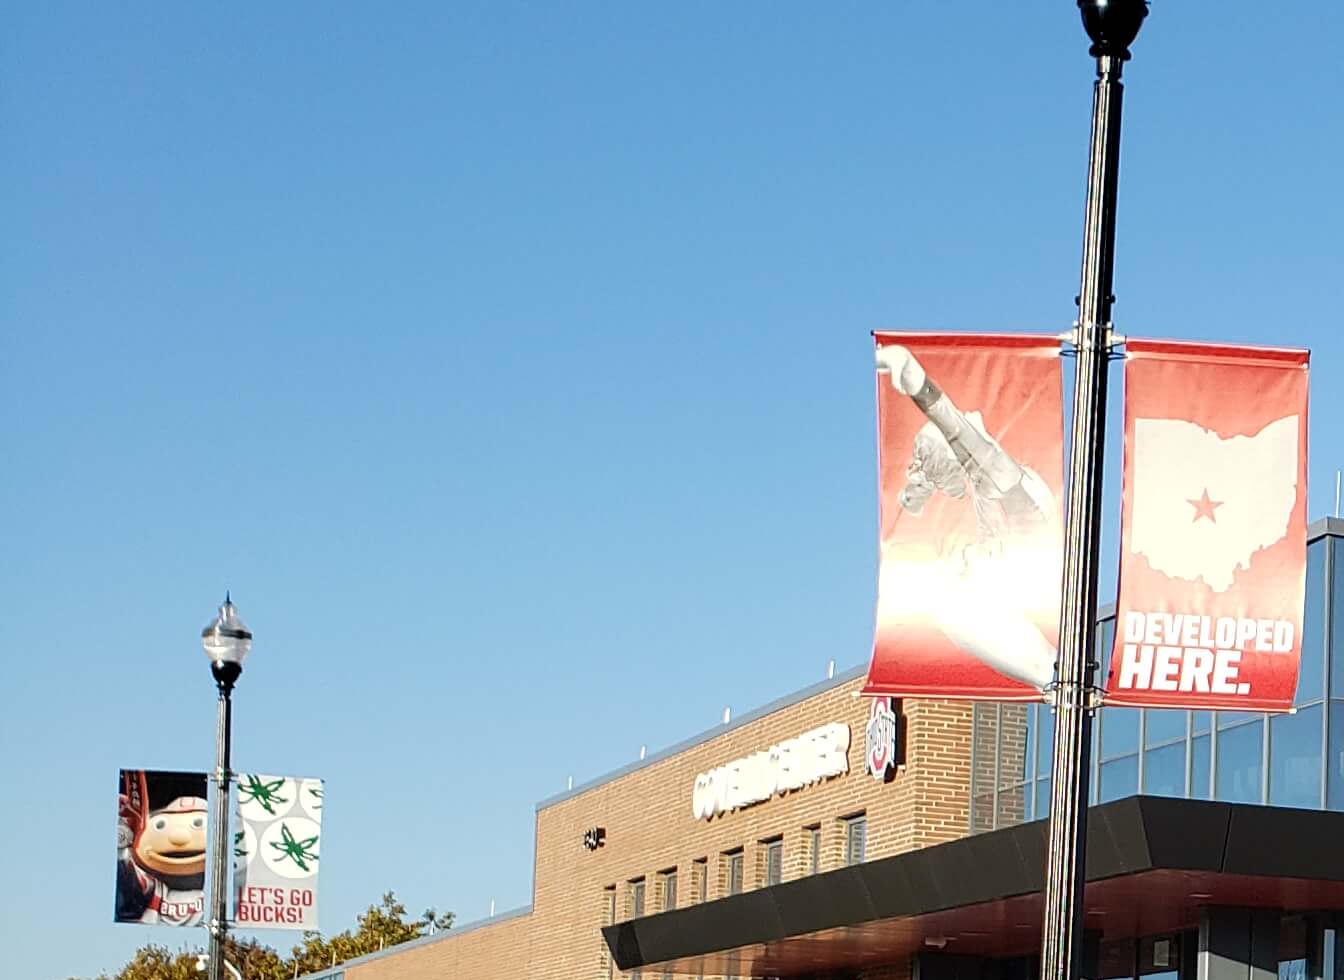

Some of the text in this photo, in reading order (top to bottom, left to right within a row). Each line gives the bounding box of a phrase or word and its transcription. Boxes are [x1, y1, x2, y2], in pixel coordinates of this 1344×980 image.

[1124, 611, 1295, 652] DEVELOPED
[1118, 643, 1250, 695] HERE.
[239, 887, 312, 907] LET'S GO
[239, 904, 303, 924] BUCKS!
